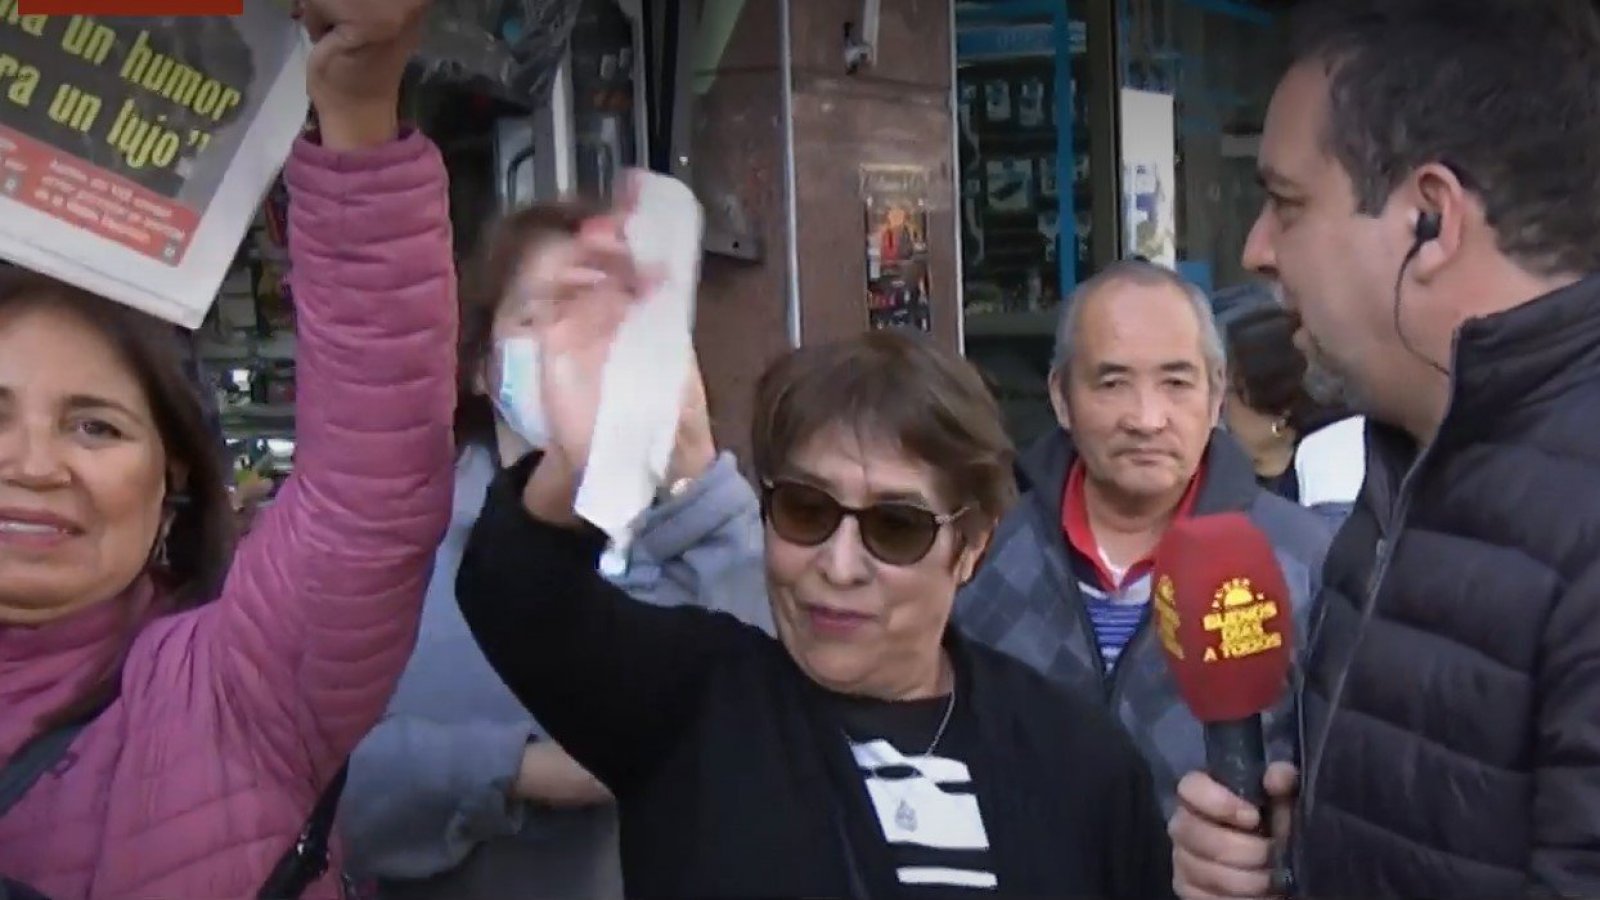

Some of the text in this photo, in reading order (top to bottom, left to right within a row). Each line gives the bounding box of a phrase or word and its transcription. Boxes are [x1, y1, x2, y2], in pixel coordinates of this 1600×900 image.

[62, 15, 116, 65] un
[120, 30, 241, 121] humor
[49, 84, 102, 133] un
[1203, 646, 1218, 662] A
